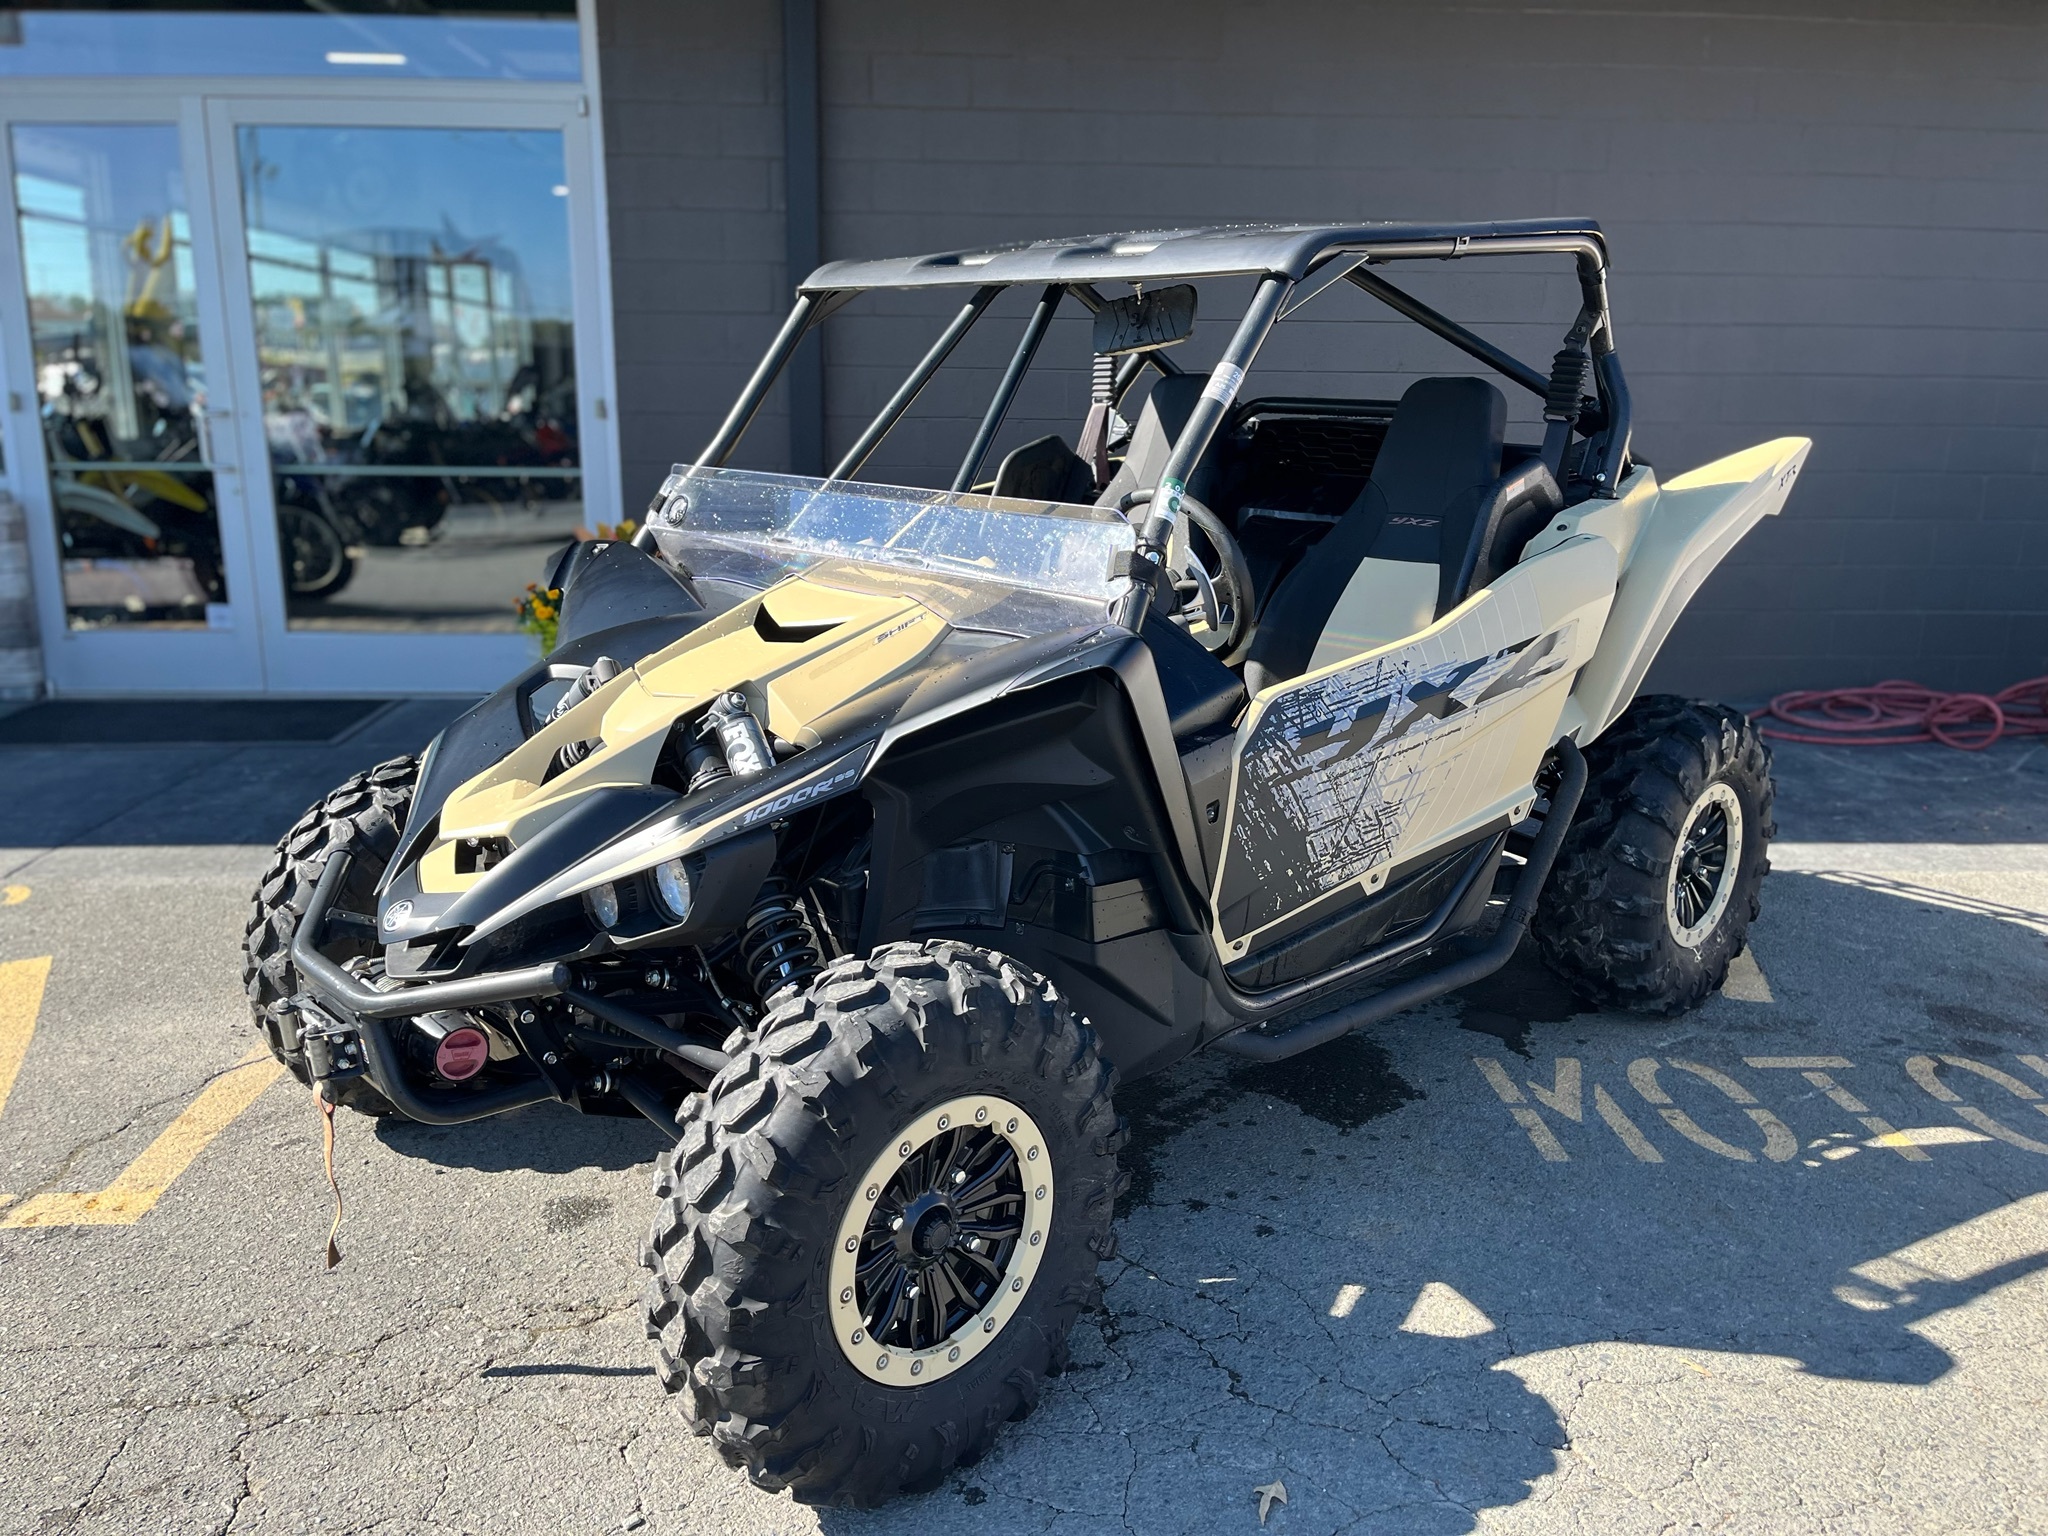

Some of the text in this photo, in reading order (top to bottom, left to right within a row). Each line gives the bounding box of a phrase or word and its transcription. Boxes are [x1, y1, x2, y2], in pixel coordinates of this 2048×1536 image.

[1388, 516, 1440, 527] YXZ
[722, 722, 763, 776] FOX
[742, 778, 834, 825] 1000R
[1473, 1055, 2048, 1163] MOTO
